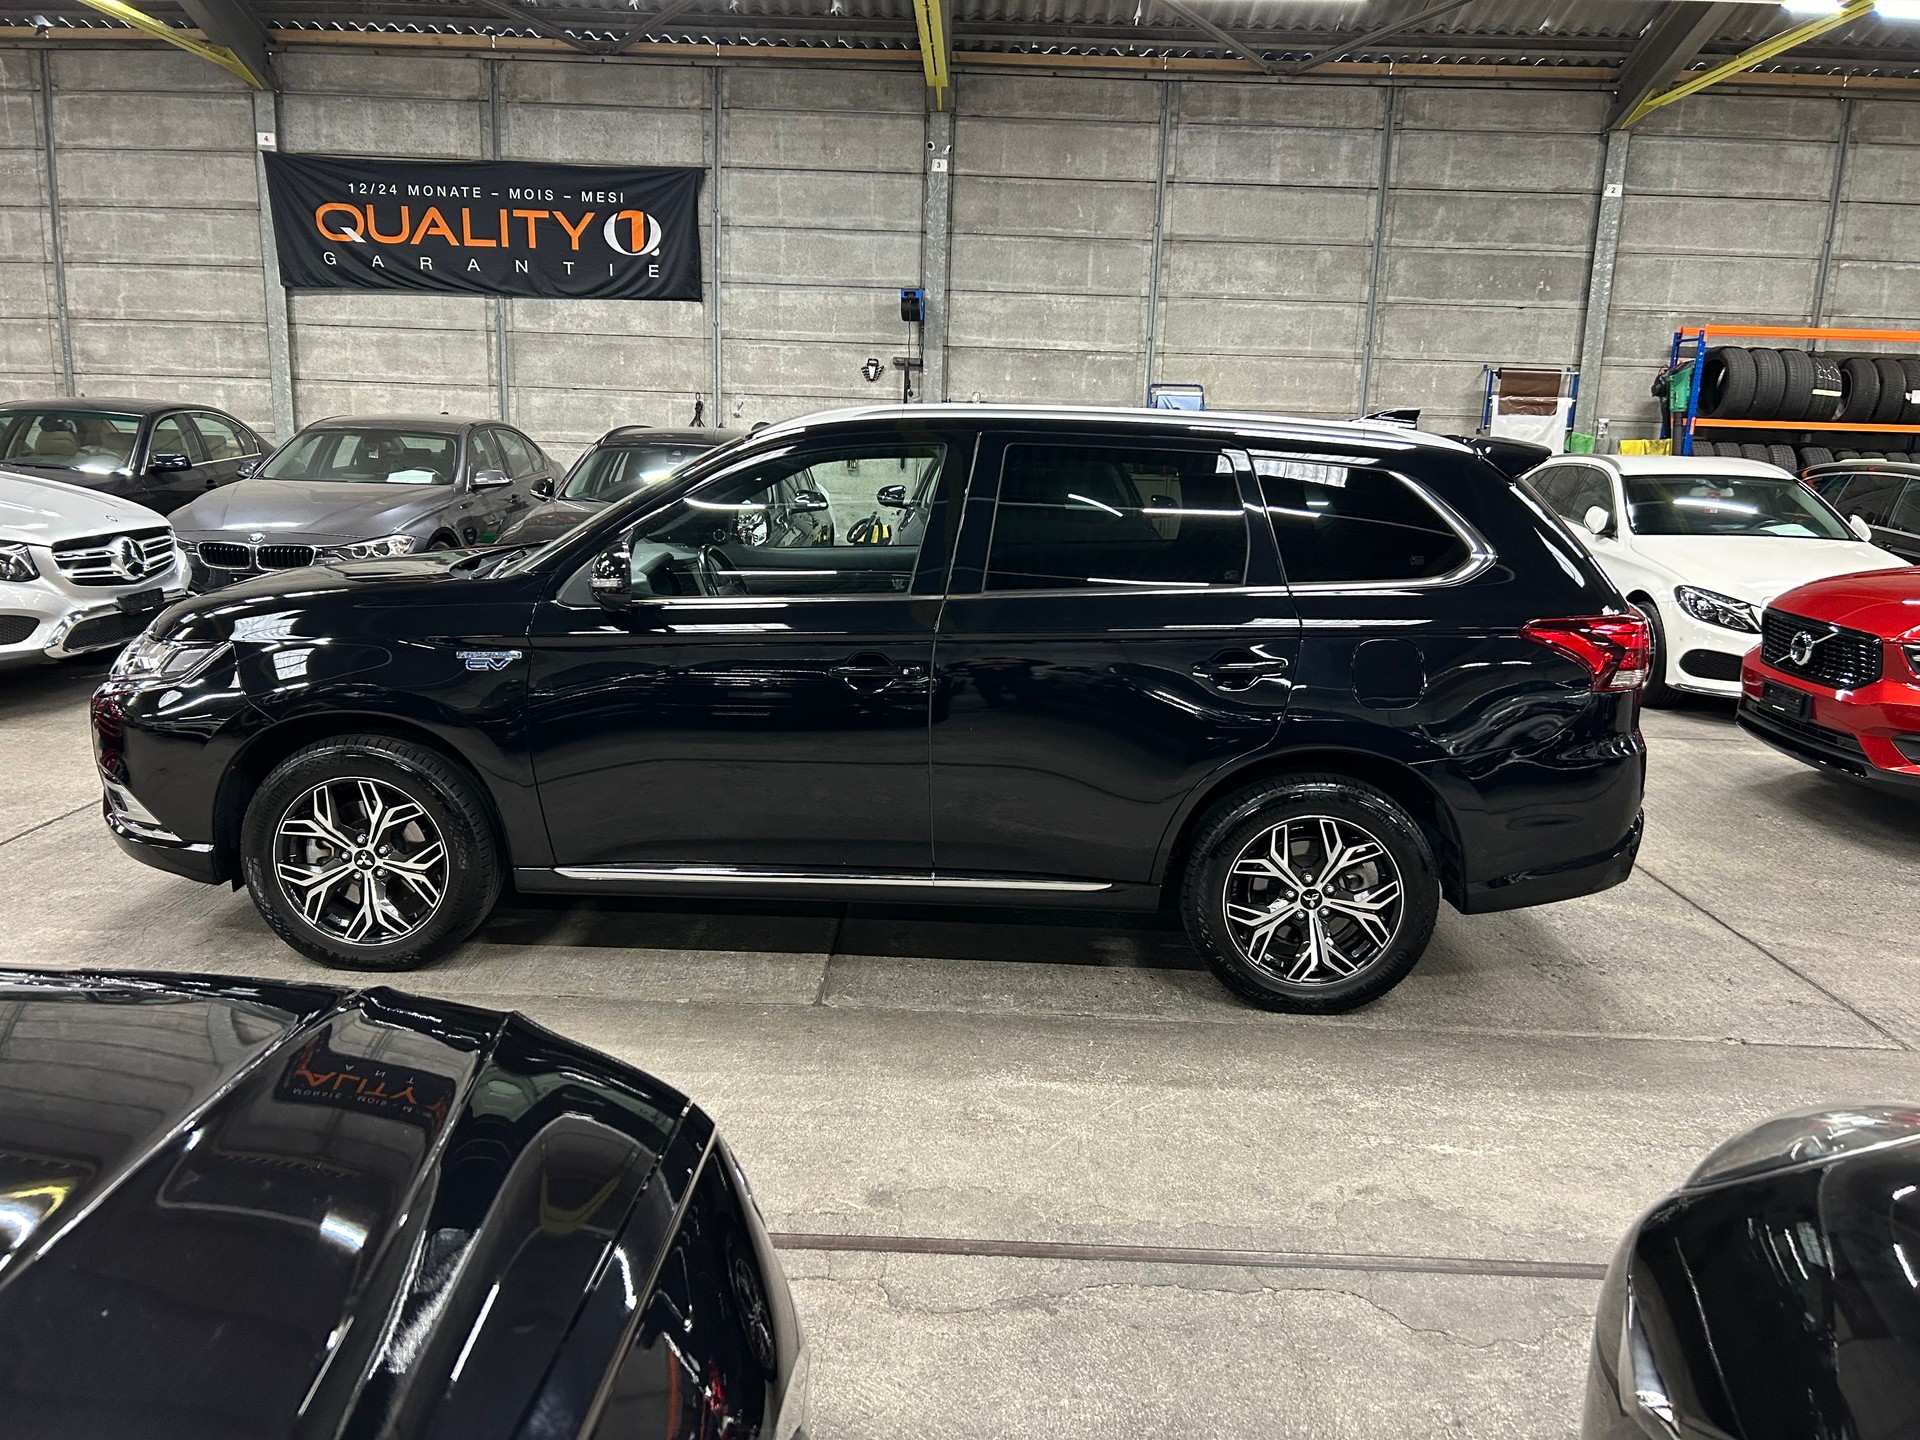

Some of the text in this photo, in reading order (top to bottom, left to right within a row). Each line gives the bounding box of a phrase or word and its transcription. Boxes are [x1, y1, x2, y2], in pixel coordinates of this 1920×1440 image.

[348, 183, 398, 195] 12/24
[407, 184, 482, 198] MONATE
[508, 188, 554, 201] MOIS
[581, 191, 624, 203] MESI
[315, 202, 596, 250] QUALITY
[323, 251, 660, 278] GARANTIE
[465, 657, 513, 671] EV
